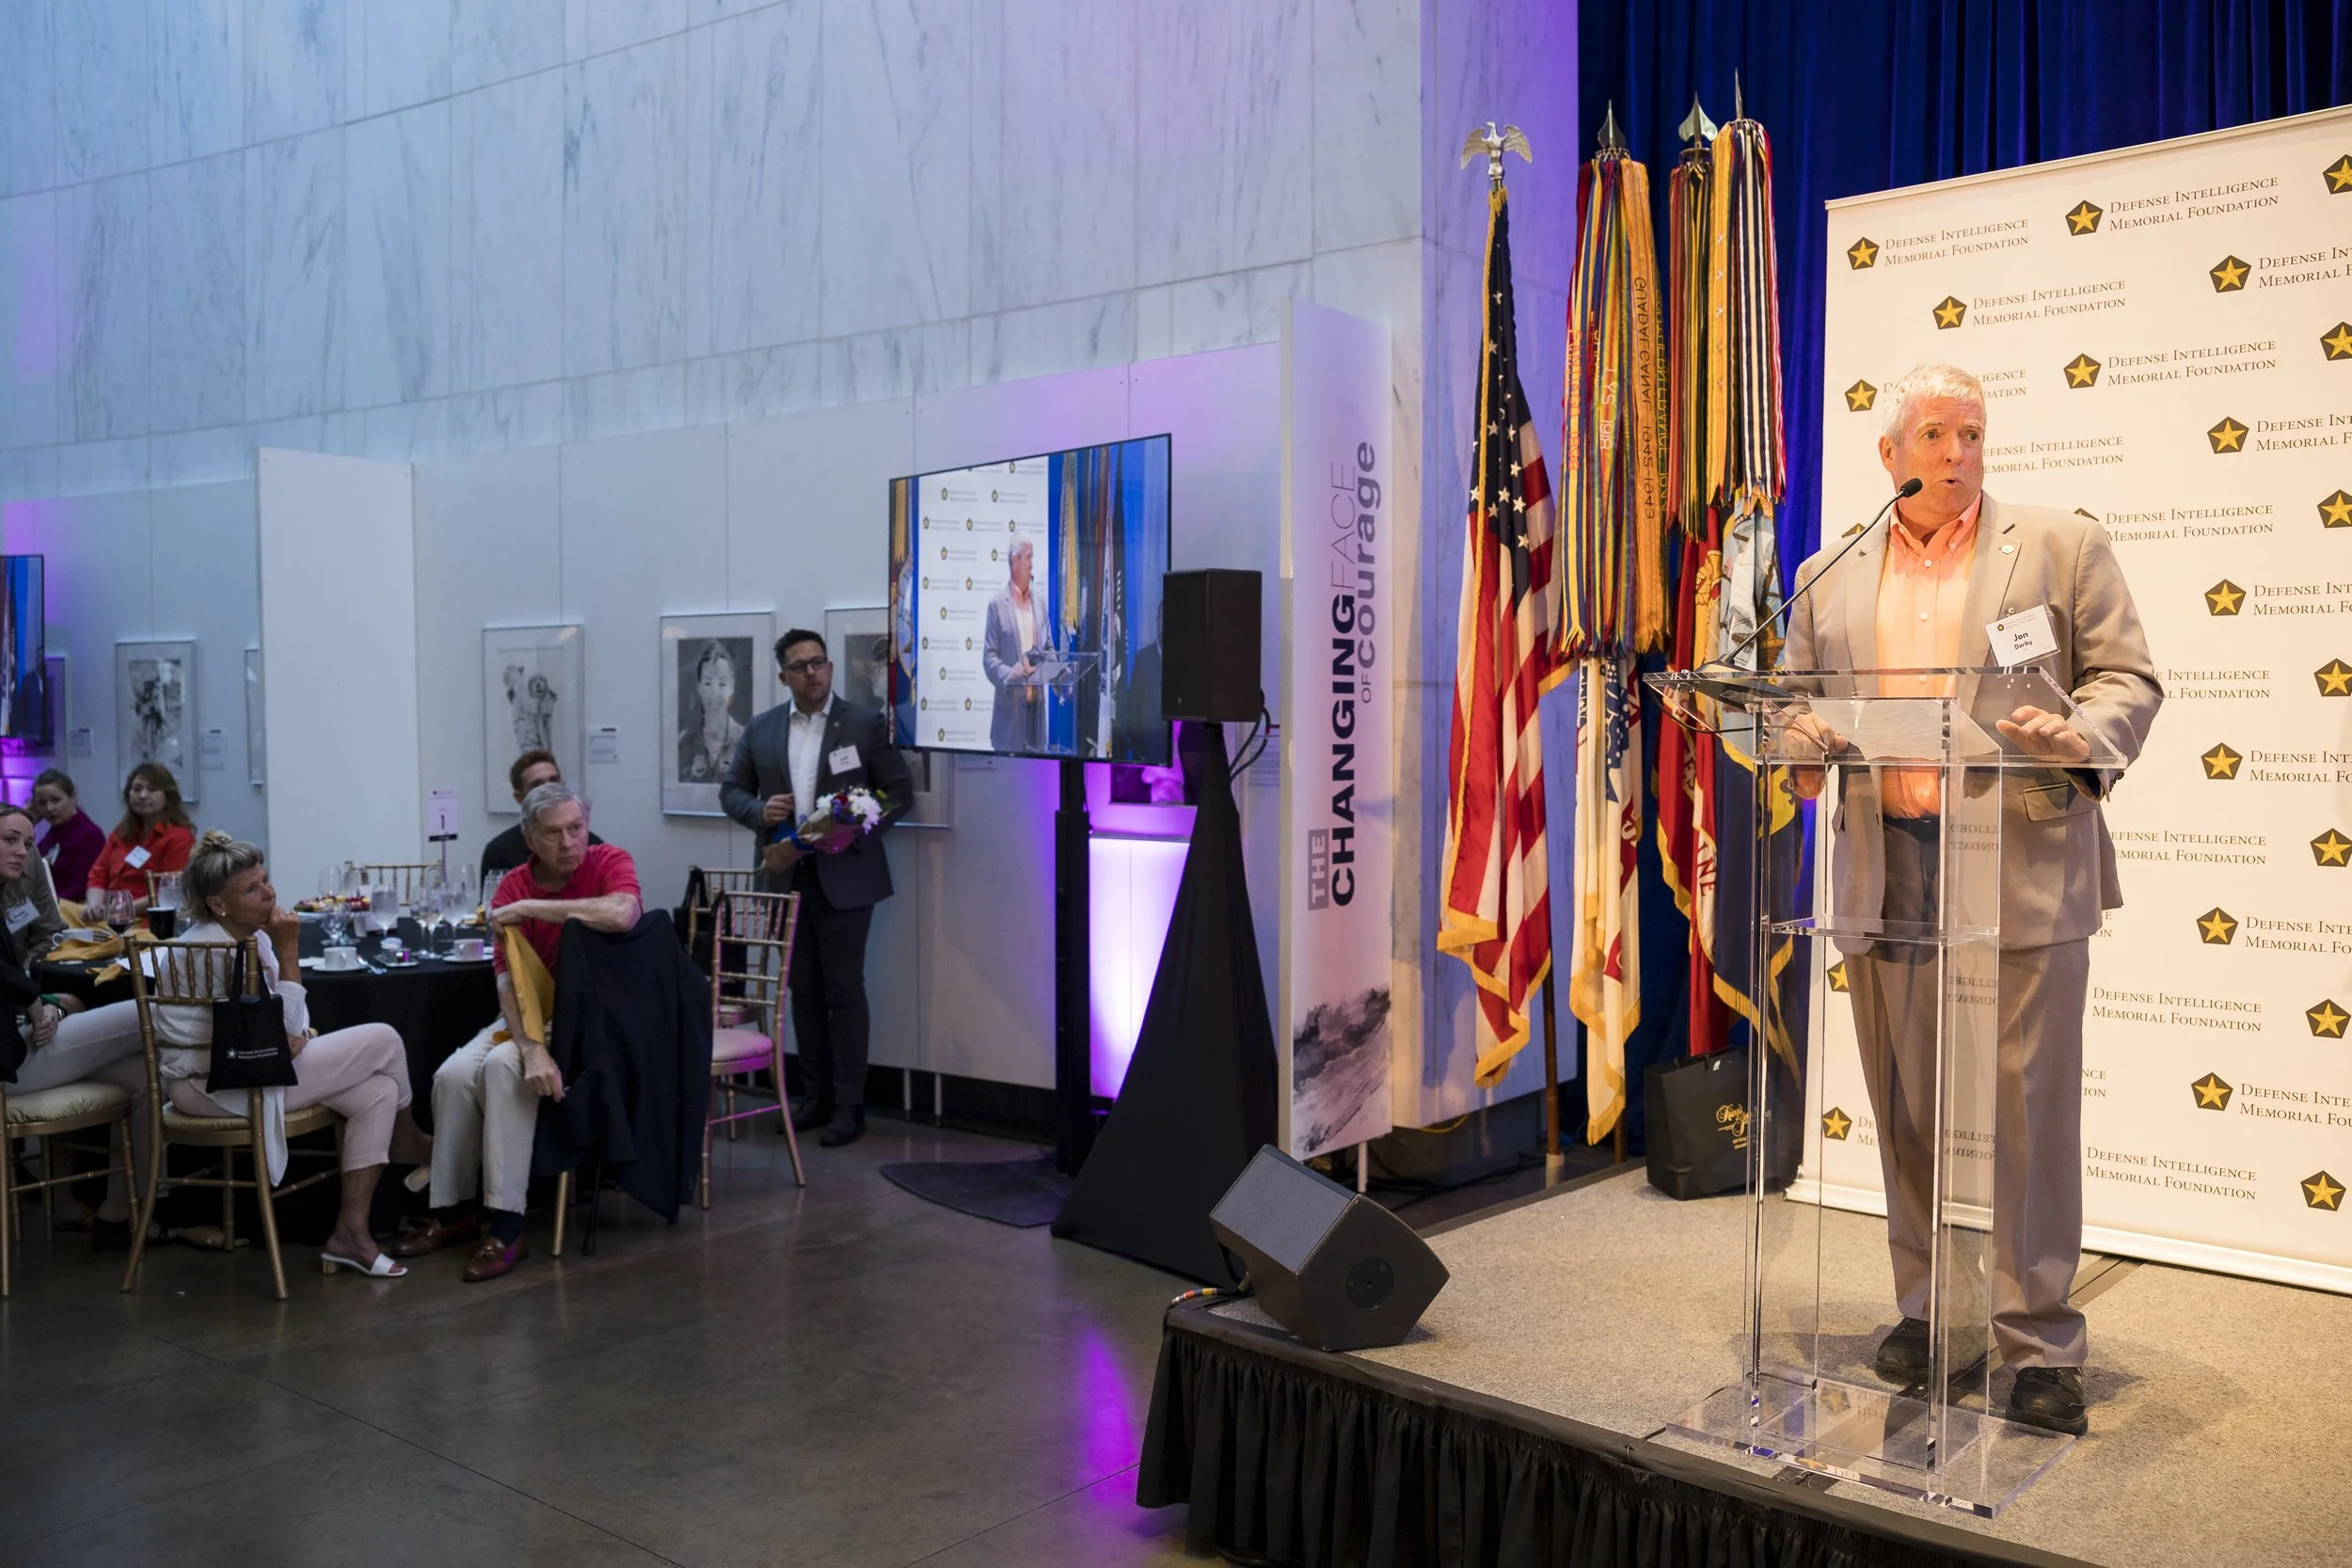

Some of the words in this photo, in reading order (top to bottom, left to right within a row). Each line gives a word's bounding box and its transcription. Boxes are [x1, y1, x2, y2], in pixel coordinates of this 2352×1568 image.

[2111, 196, 2170, 213] DEFENSE
[2175, 177, 2278, 202] INTELLIGENCE
[2110, 212, 2183, 230] MEMORIAL
[2187, 196, 2279, 218] FOUNDATION
[1885, 234, 1937, 249] DEFENSE
[1942, 219, 2027, 241] INTELLIGENCE
[1885, 249, 1947, 265] MEMORIAL
[1952, 237, 2027, 255] FOUNDATION
[2259, 252, 2326, 270] DEFENSE
[2259, 269, 2341, 288] MEMORIAL
[1974, 294, 2027, 309] DEFENSE
[2033, 281, 2124, 301] INTELLIGENCE
[1974, 310, 2040, 325] MEMORIAL
[2044, 298, 2125, 316] FOUNDATION
[2109, 354, 2168, 368] DEFENSE
[2174, 341, 2276, 360] INTELLIGENCE
[1982, 370, 2026, 383] IGENCE
[2108, 371, 2181, 386] MEMORIAL
[2186, 359, 2276, 377] FOUNDATION
[1984, 387, 2026, 401] DATION
[2257, 419, 2323, 433] DEFENSE
[1983, 446, 2026, 457] EFENSE
[2031, 436, 2122, 452] INTELLIGENCE
[2257, 436, 2338, 451] MEMORIAL
[1983, 461, 2038, 474] EMORIAL
[2042, 454, 2122, 468] FOUNDATION
[2106, 513, 2166, 524] DEFENSE
[2171, 505, 2273, 519] INTELLIGENCE
[2106, 530, 2179, 542] MEMORIAL
[2185, 524, 2273, 537] FOUNDATION
[2254, 585, 2320, 596] DEFENSE
[2253, 604, 2335, 615] MEMORIAL
[2014, 632, 2028, 641] Jon
[2014, 641, 2033, 650] Darby
[2169, 670, 2269, 680] INTELLIGENCE
[1360, 673, 1372, 704] OF
[2181, 688, 2269, 699] FOUNDATION
[2250, 751, 2316, 763] DEFENSE
[2250, 769, 2330, 782] MEMORIAL
[2111, 831, 2158, 842] EFENSE
[2164, 831, 2265, 846] INTELLIGENCE
[2176, 849, 2265, 864] FOUNDATION
[1311, 834, 1326, 905] THE
[2247, 917, 2312, 932] DEFENSE
[2246, 936, 2327, 952] MEMORIAL
[2094, 988, 2153, 1003] DEFENSE
[2159, 993, 2261, 1013] INTELLIGENCE
[2093, 1006, 2166, 1022] MEMORIAL
[2171, 1012, 2261, 1031] FOUNDATION
[2241, 1084, 2308, 1102] DEFENSE
[2240, 1102, 2322, 1123] MEMORIAL
[2088, 1147, 2147, 1165] DEFENSE
[2153, 1156, 2255, 1180] INTELLIGENCE
[2087, 1165, 2160, 1186] MEMORIAL
[2166, 1176, 2256, 1199] FOUNDATION
